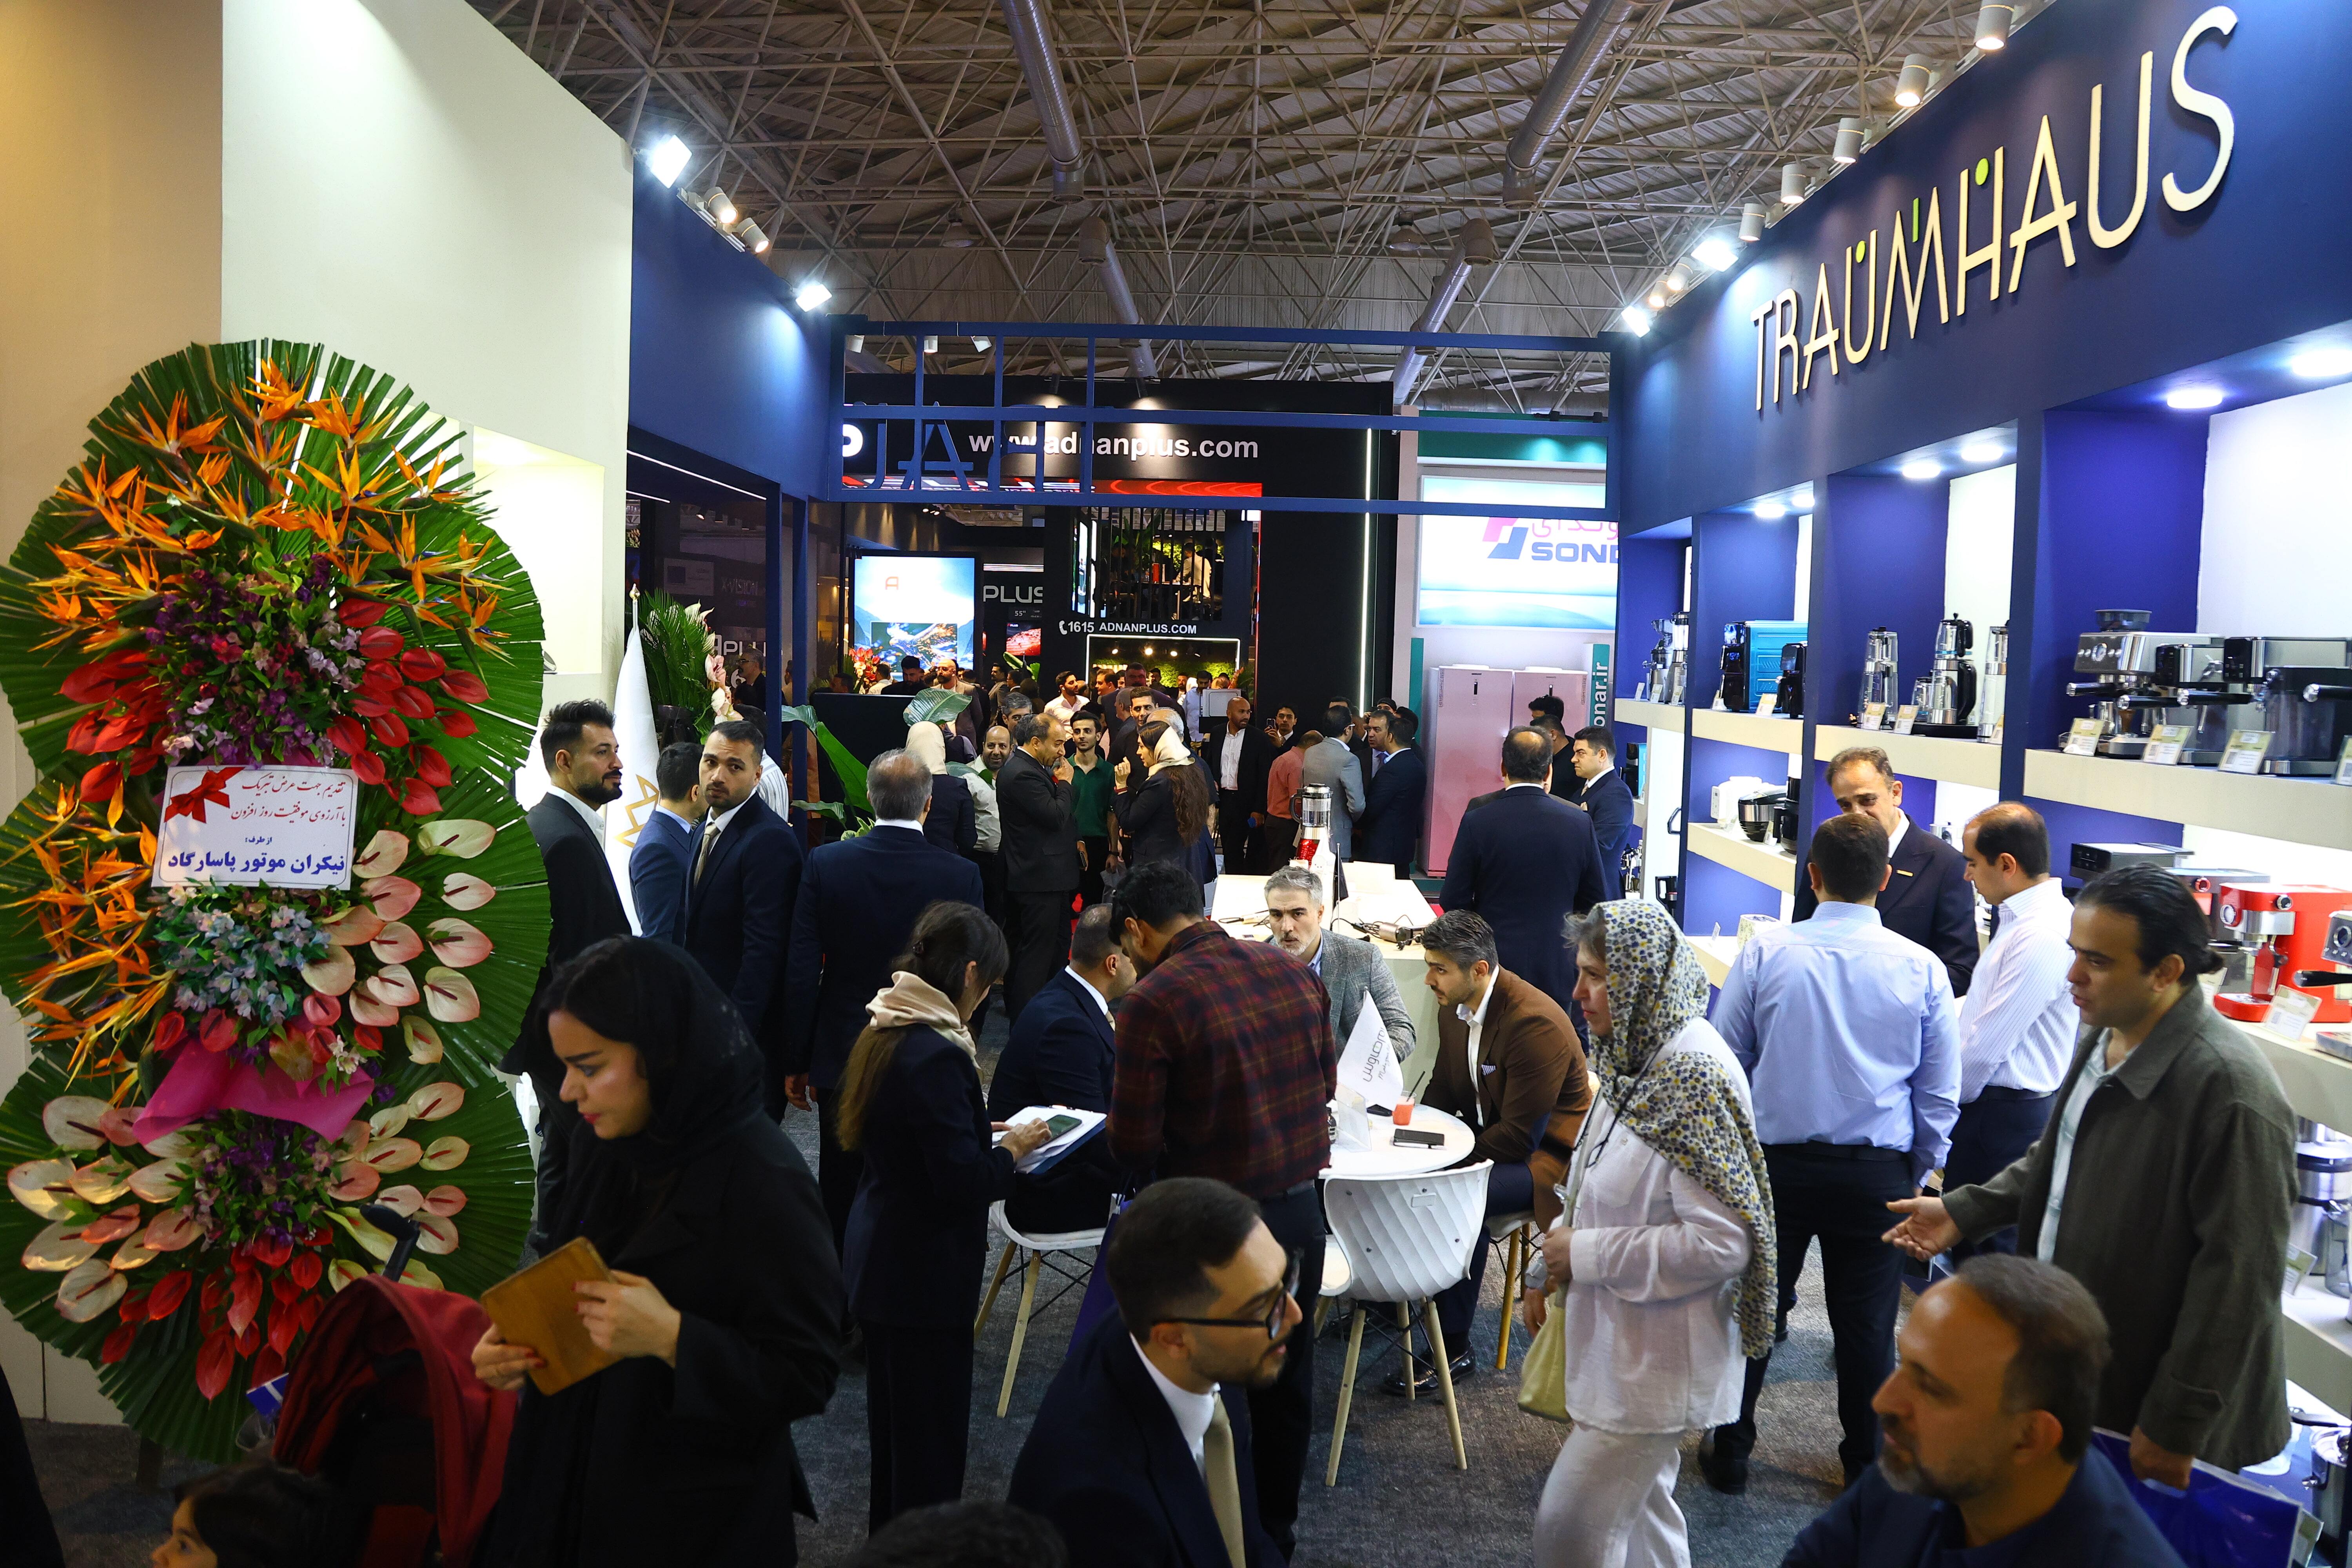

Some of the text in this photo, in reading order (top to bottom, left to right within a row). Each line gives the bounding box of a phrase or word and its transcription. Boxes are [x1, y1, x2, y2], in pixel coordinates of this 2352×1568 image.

[1751, 5, 2238, 410] TRAUMHAUS
[969, 431, 1258, 461] wwadanplus.com
[1068, 621, 1197, 634] 1615 ADNANPLUS.COM
[242, 772, 346, 800] تقدیم جهت عرض تبریک
[274, 801, 309, 823] موفقیت
[309, 806, 345, 822] آرزوی
[341, 811, 346, 827] با
[265, 837, 272, 845] از
[168, 851, 345, 875] نیکران موتور پاسارگاد
